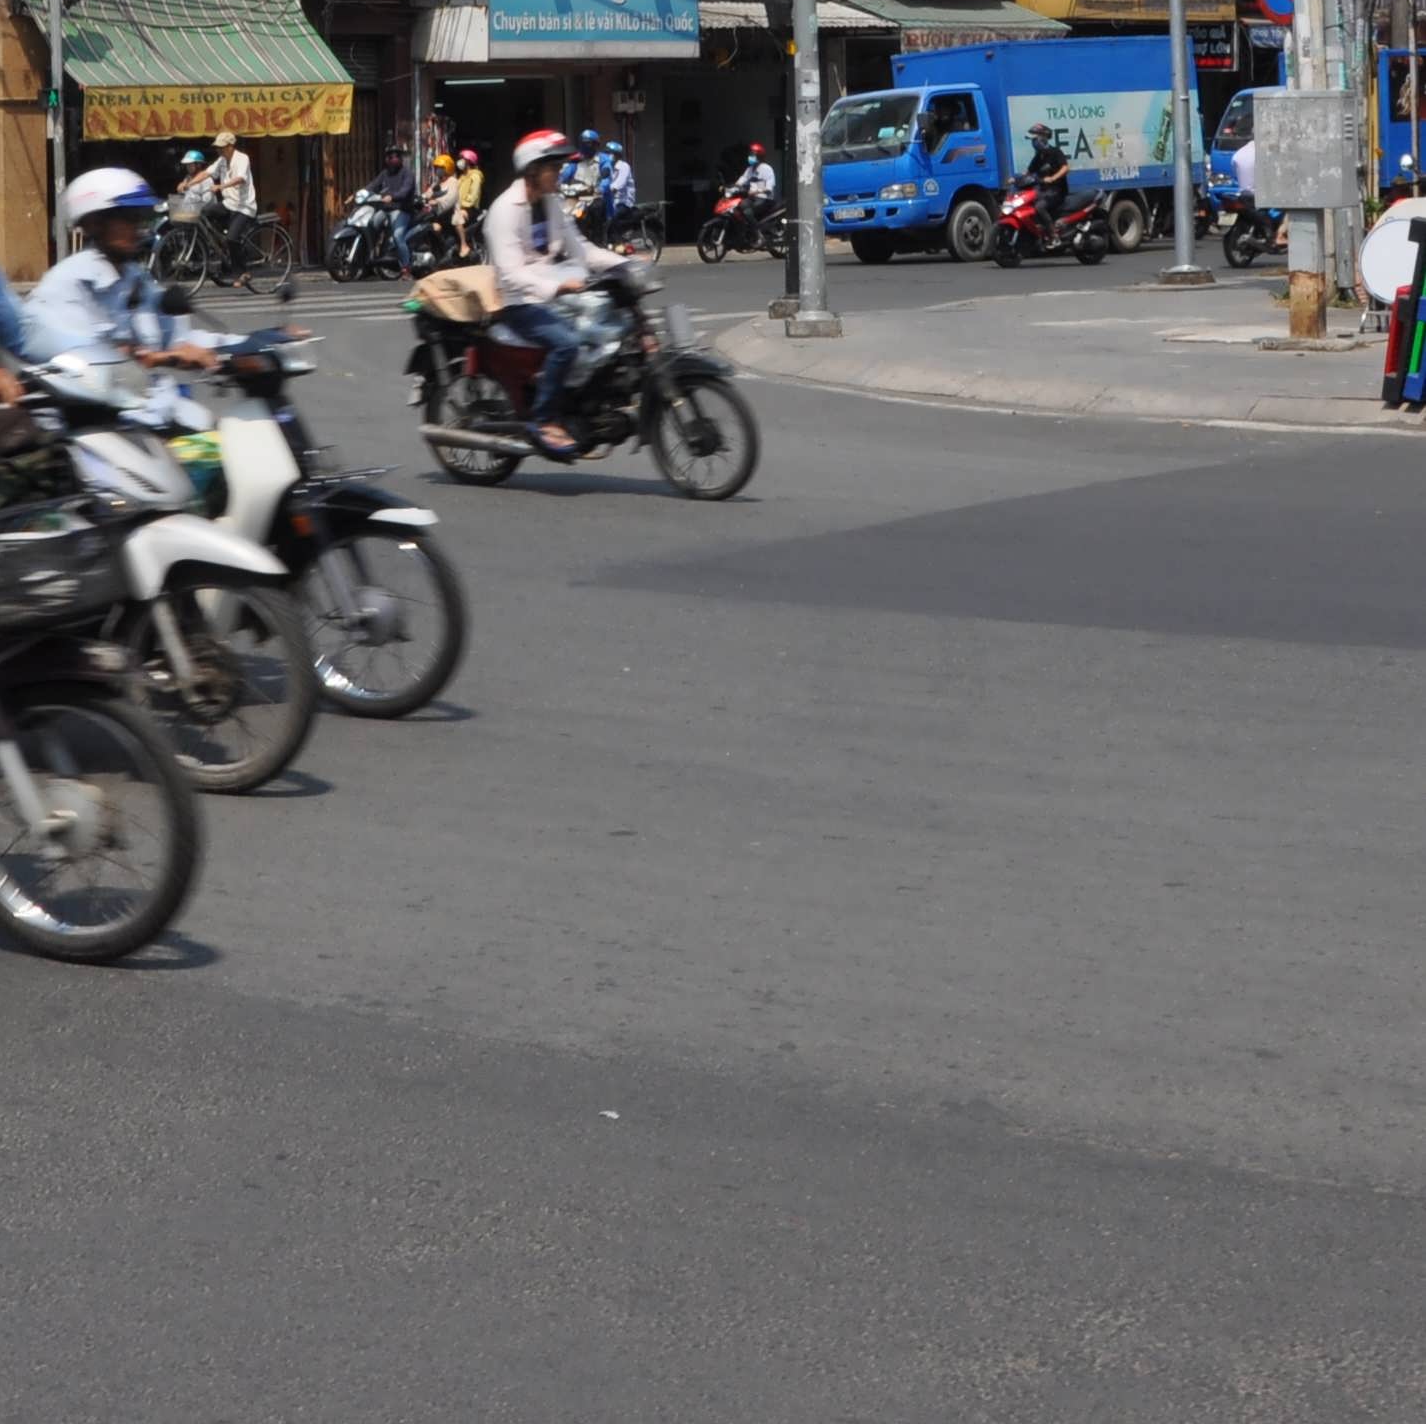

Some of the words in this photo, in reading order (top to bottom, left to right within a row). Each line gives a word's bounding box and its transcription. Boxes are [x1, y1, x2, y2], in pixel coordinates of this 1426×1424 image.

[493, 10, 536, 36] Chuyên
[538, 10, 560, 31] bán
[665, 9, 694, 32] Quốc
[180, 91, 226, 105] SHOP
[231, 87, 274, 104] TRÁI
[280, 87, 317, 103] CÂY
[326, 92, 349, 107] 47
[117, 109, 195, 134] NAM
[204, 107, 293, 132] LONG
[1046, 104, 1065, 120] TRÀ
[1068, 105, 1076, 120] Ô
[1078, 106, 1106, 119] LONG
